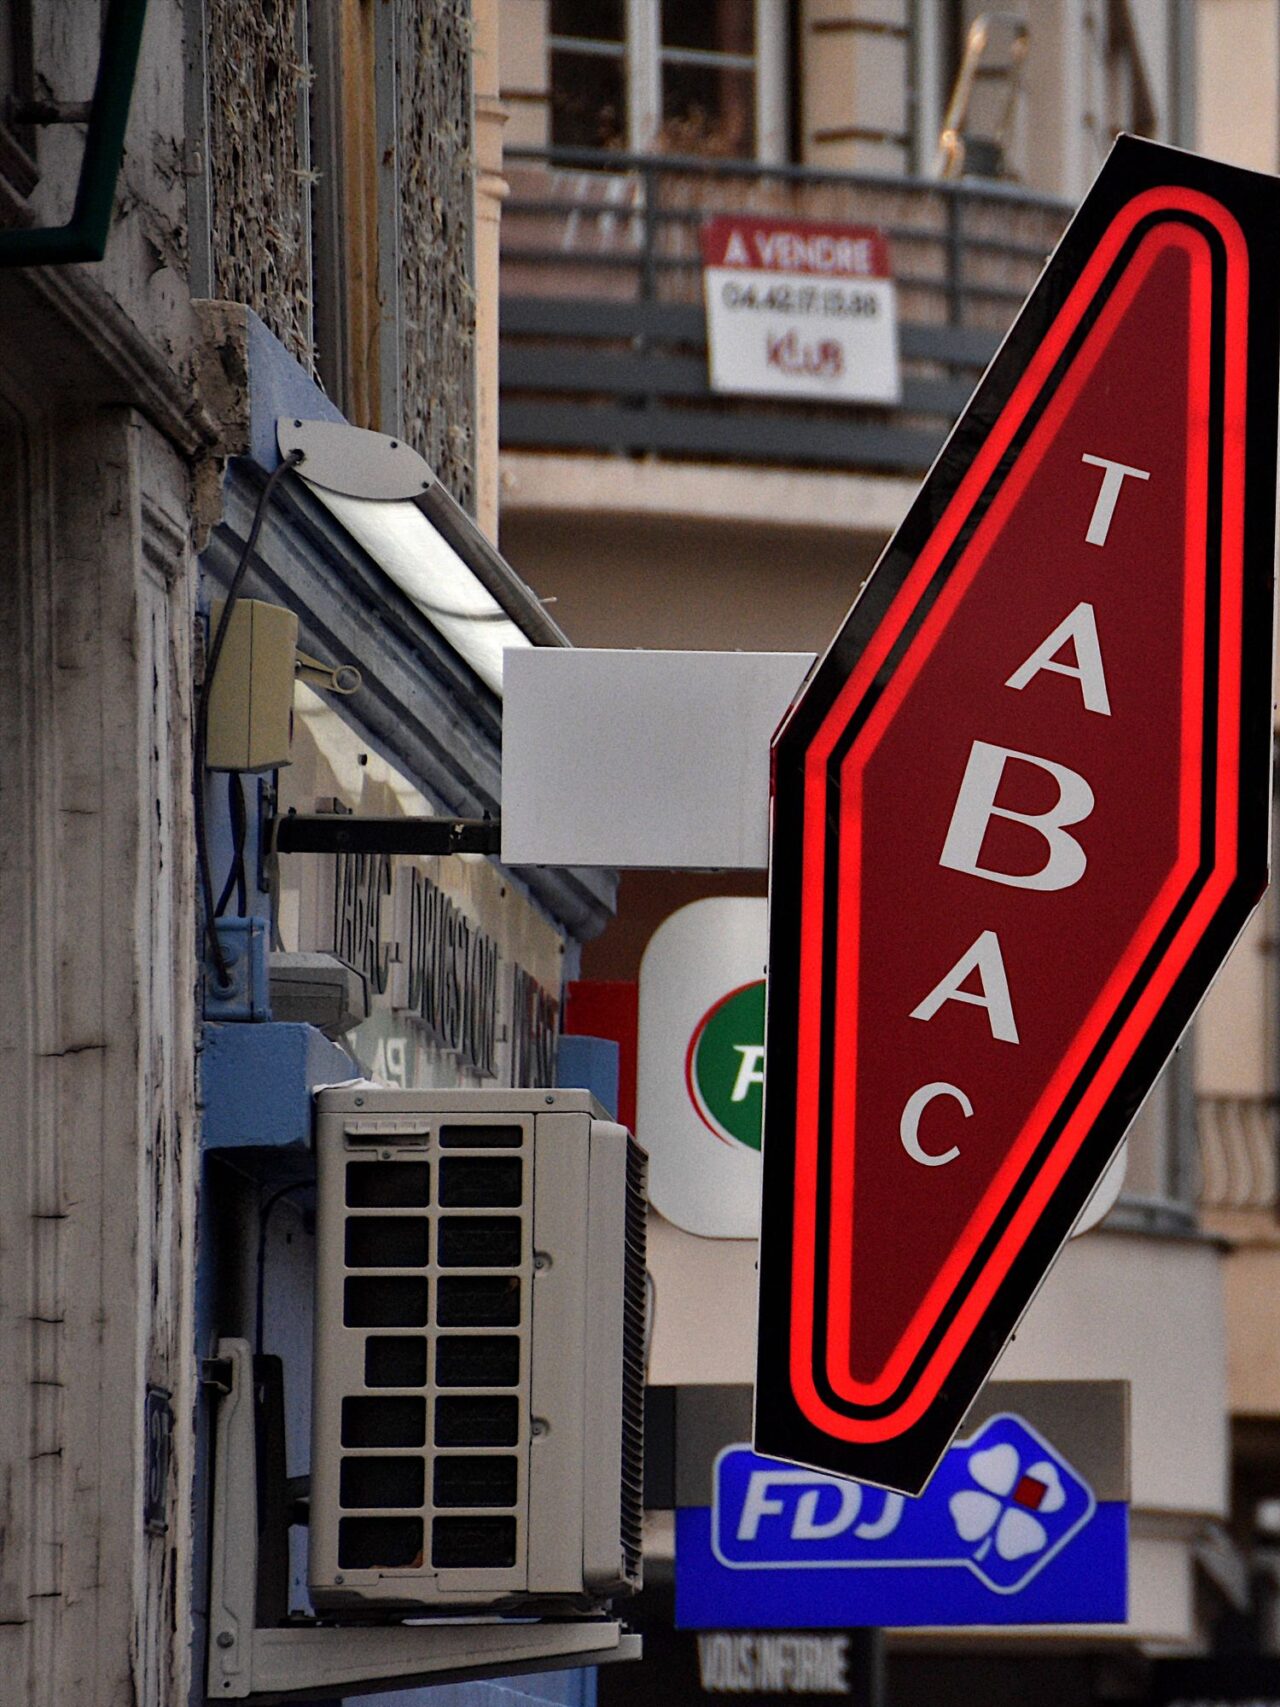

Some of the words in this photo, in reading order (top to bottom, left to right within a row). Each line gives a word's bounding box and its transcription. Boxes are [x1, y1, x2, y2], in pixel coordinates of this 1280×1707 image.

[723, 227, 749, 265] A
[753, 229, 872, 275] VENDRE
[899, 453, 1151, 1168] TABAC
[736, 1470, 905, 1541] FDJ
